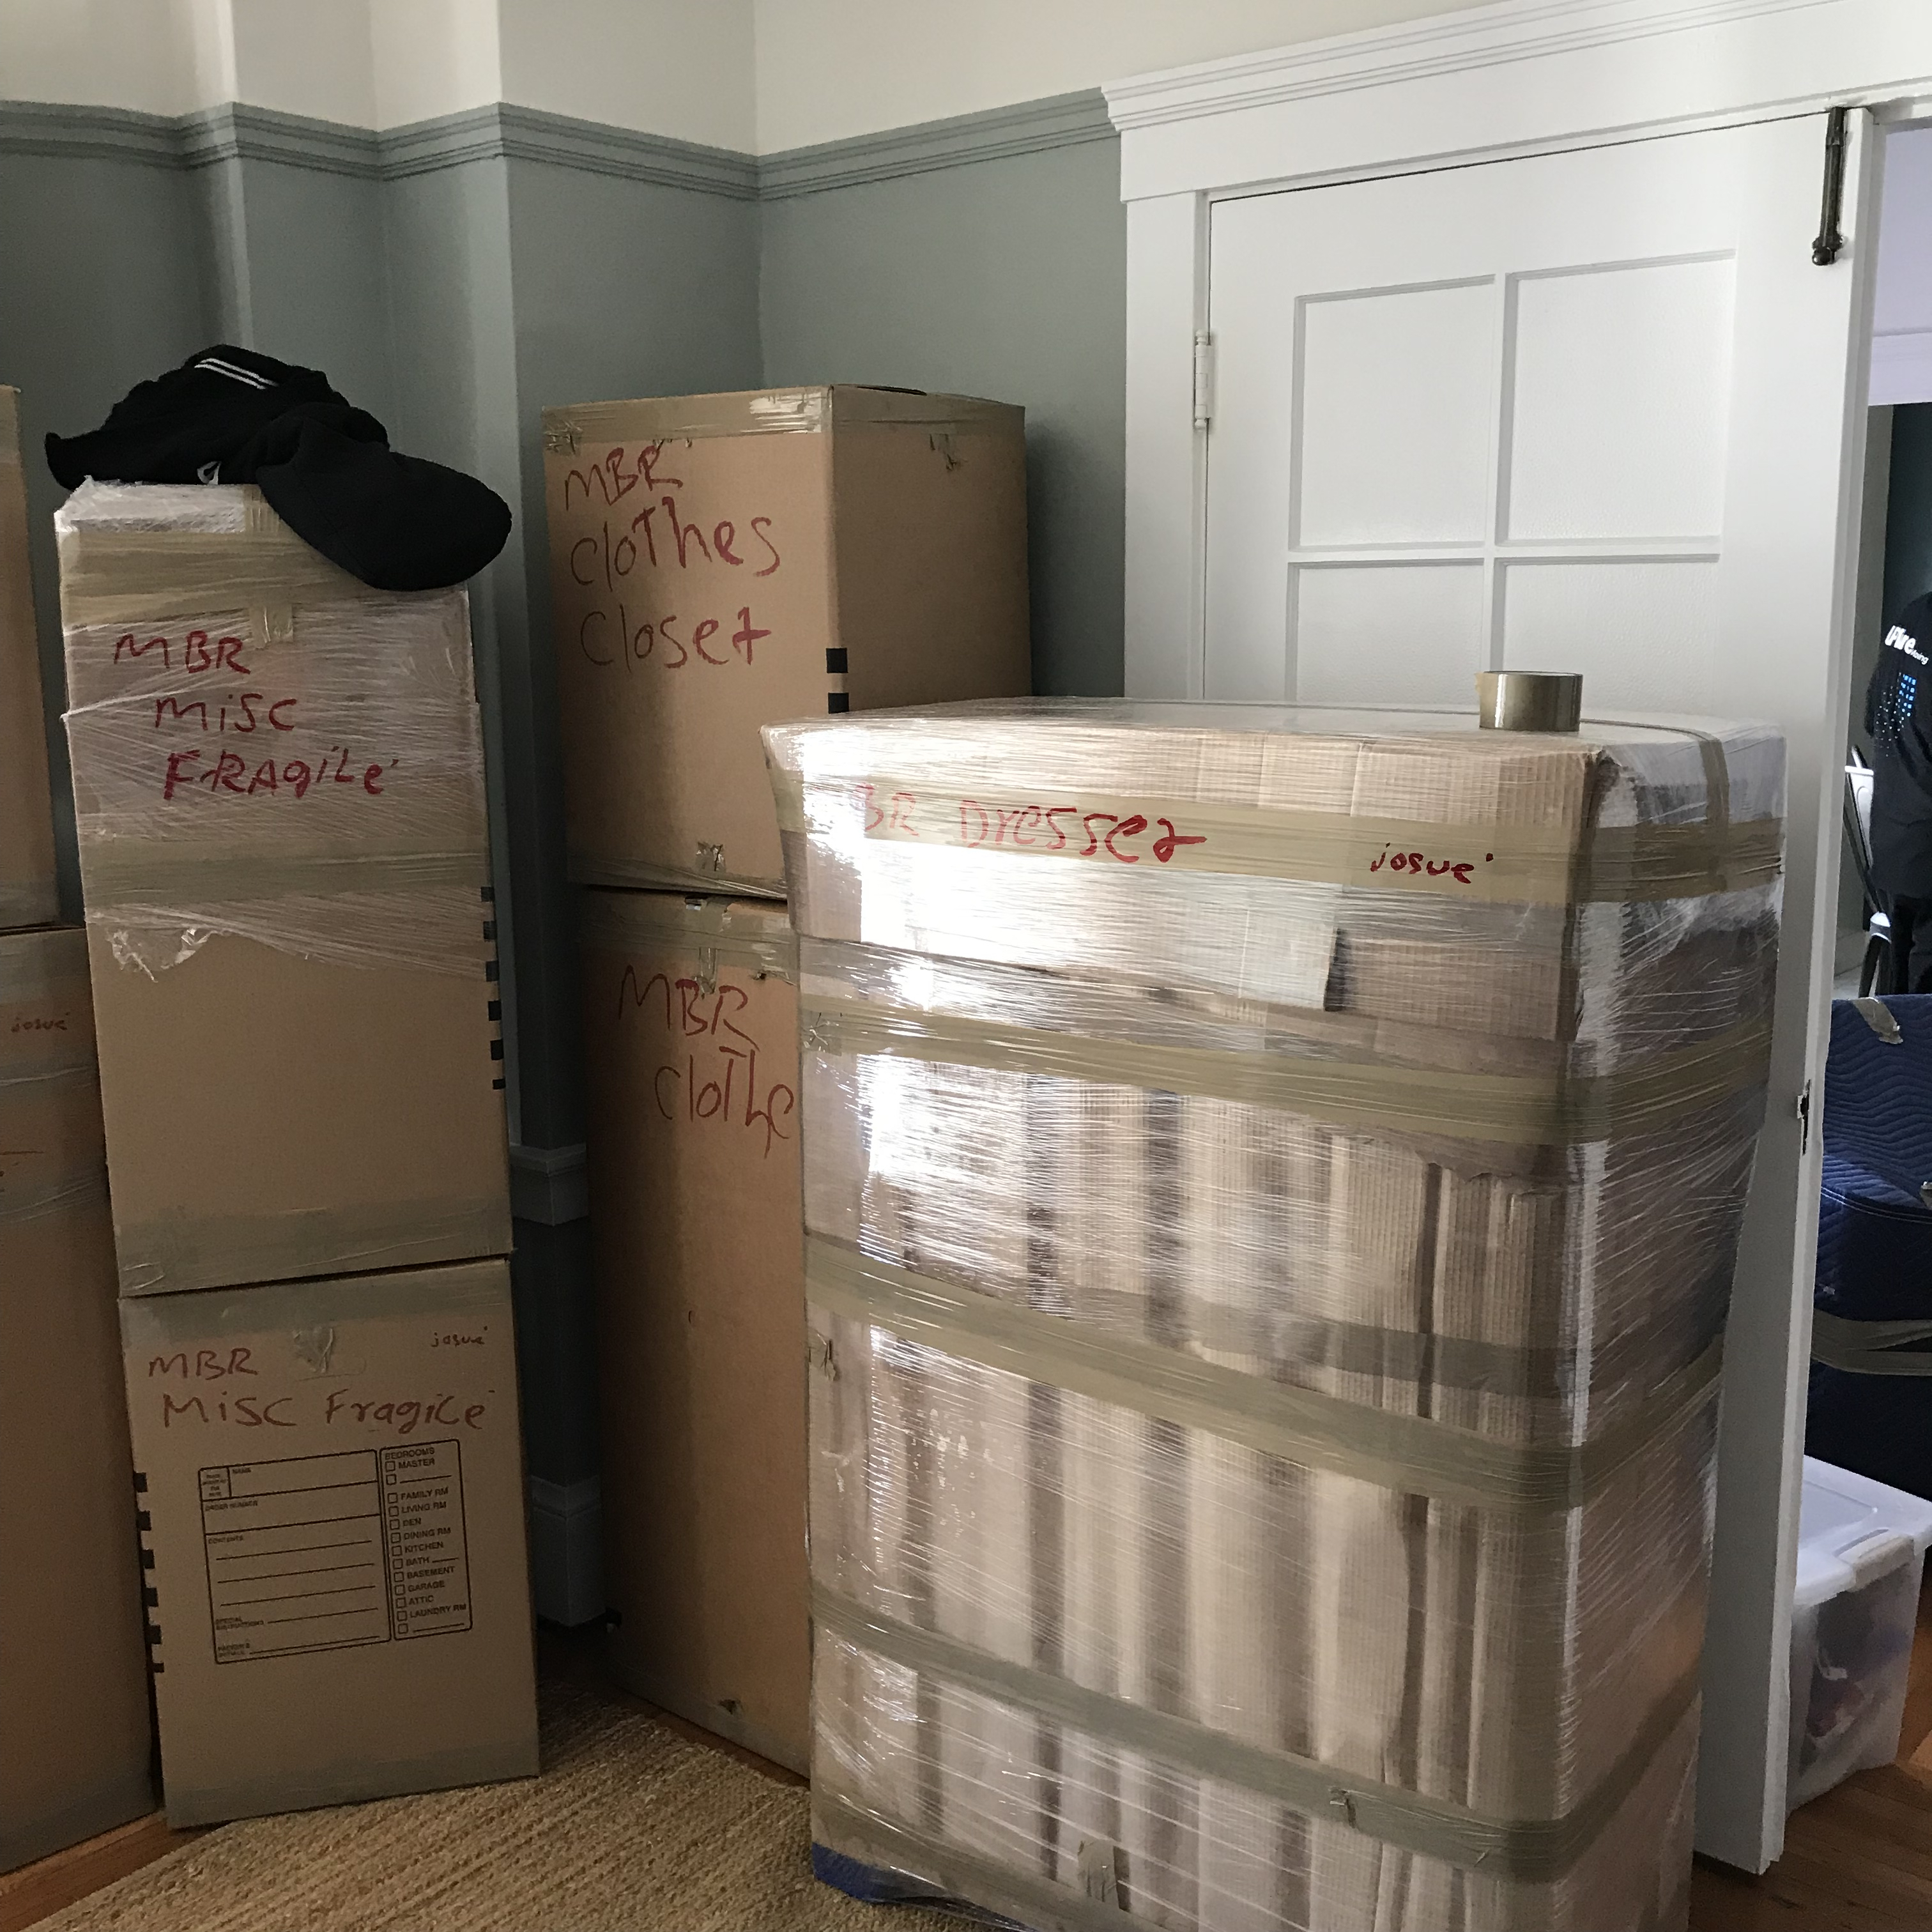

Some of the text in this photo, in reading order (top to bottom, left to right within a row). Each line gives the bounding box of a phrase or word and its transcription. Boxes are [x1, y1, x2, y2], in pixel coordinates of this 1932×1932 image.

[565, 446, 683, 510] MBR
[113, 631, 250, 674] MBR
[852, 782, 920, 837] BR
[618, 965, 760, 1052] MBR
[148, 1347, 257, 1380] MBR
[385, 1447, 434, 1460] BEDROOMS
[399, 1458, 435, 1468] MASTER
[401, 1487, 448, 1500] FAMILY RM
[402, 1503, 430, 1514] LIVING
[403, 1518, 421, 1527] DEN
[404, 1529, 434, 1540] DINING
[405, 1541, 443, 1553] KITCHEN
[406, 1556, 429, 1566] BATH
[407, 1566, 455, 1579] BASEMENT
[408, 1580, 445, 1591] GARAGE
[409, 1595, 434, 1605] ATTIC
[410, 1606, 451, 1618] LAUNDRY
